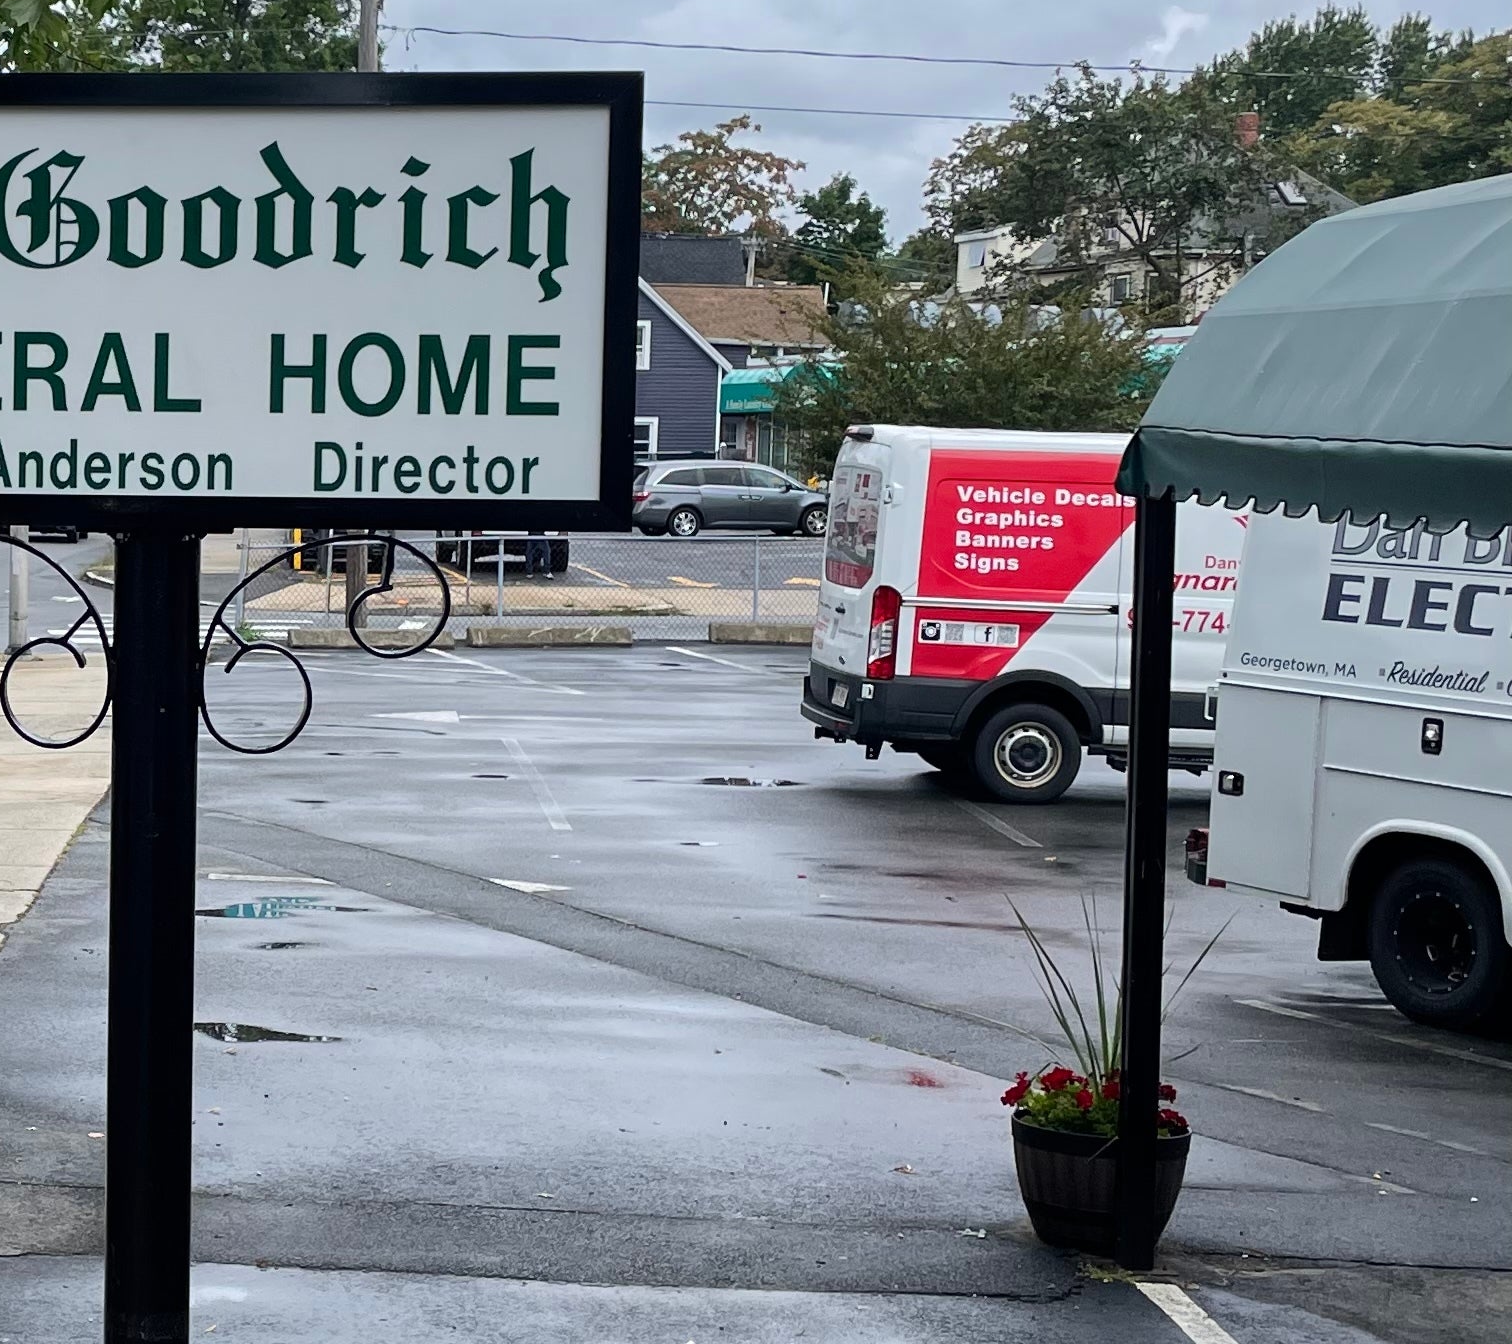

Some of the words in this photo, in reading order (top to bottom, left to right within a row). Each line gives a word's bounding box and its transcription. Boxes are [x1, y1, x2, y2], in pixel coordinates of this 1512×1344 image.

[270, 332, 560, 417] HOME
[314, 441, 539, 493] Director
[957, 485, 1046, 505] Vehicle
[1055, 488, 1136, 507] Decals
[956, 508, 1064, 529] Graphics
[955, 530, 1054, 550] Banners
[954, 552, 1019, 574] Signs
[1322, 573, 1512, 639] ELEC
[1240, 652, 1329, 677] Georgetown,
[1334, 662, 1357, 679] MA
[1386, 660, 1490, 694] Residential
